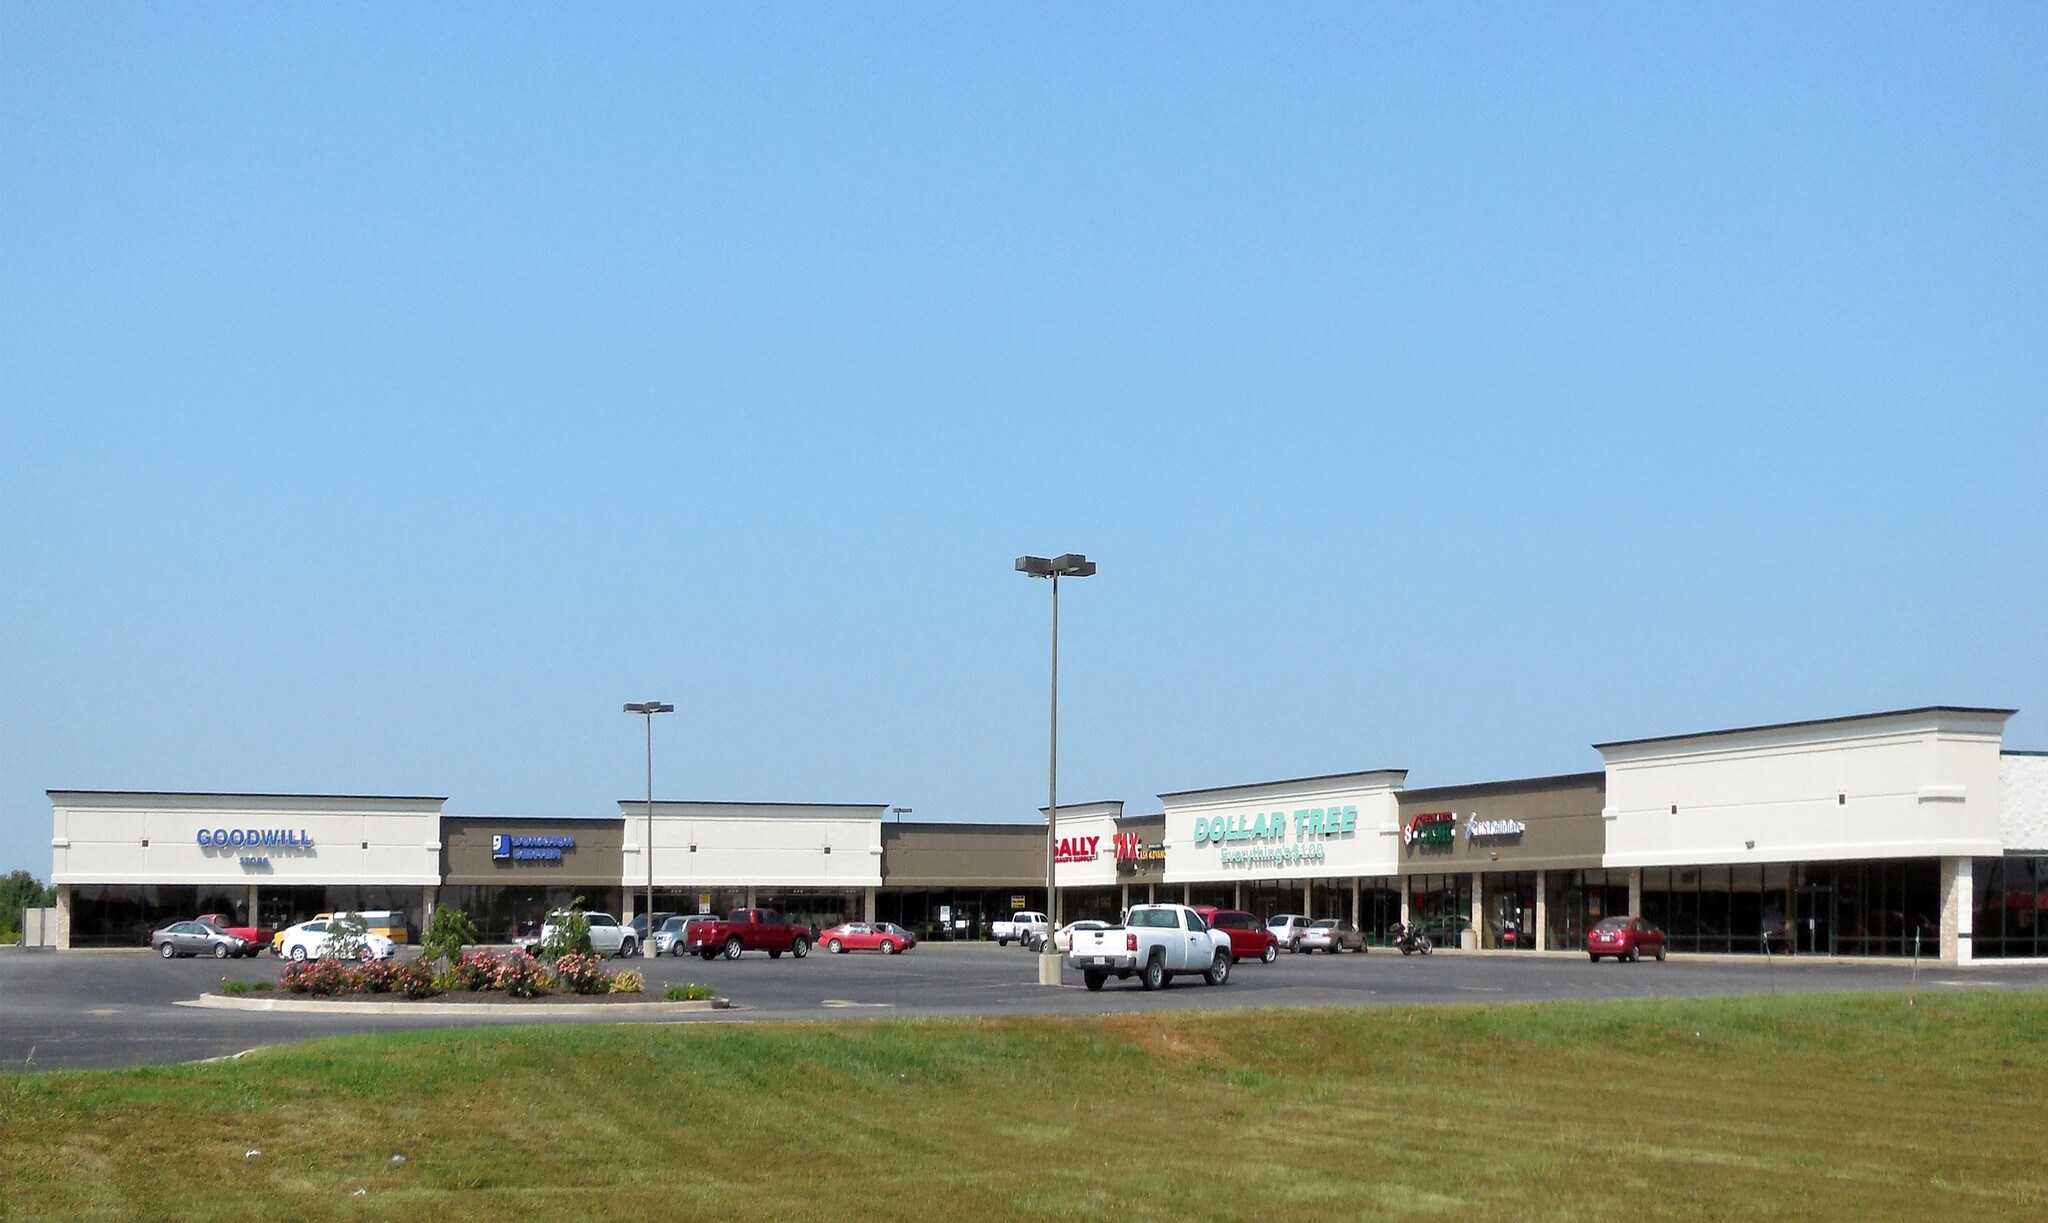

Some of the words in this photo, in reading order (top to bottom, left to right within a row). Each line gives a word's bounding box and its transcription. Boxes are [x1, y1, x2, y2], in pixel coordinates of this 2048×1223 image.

[1194, 811, 1286, 843] DOLLAR
[1293, 804, 1357, 836] TREE
[196, 828, 317, 846] GOODWILL
[1113, 833, 1139, 859] TAX
[239, 856, 270, 865] STORE
[1220, 844, 1292, 865] Everything's
